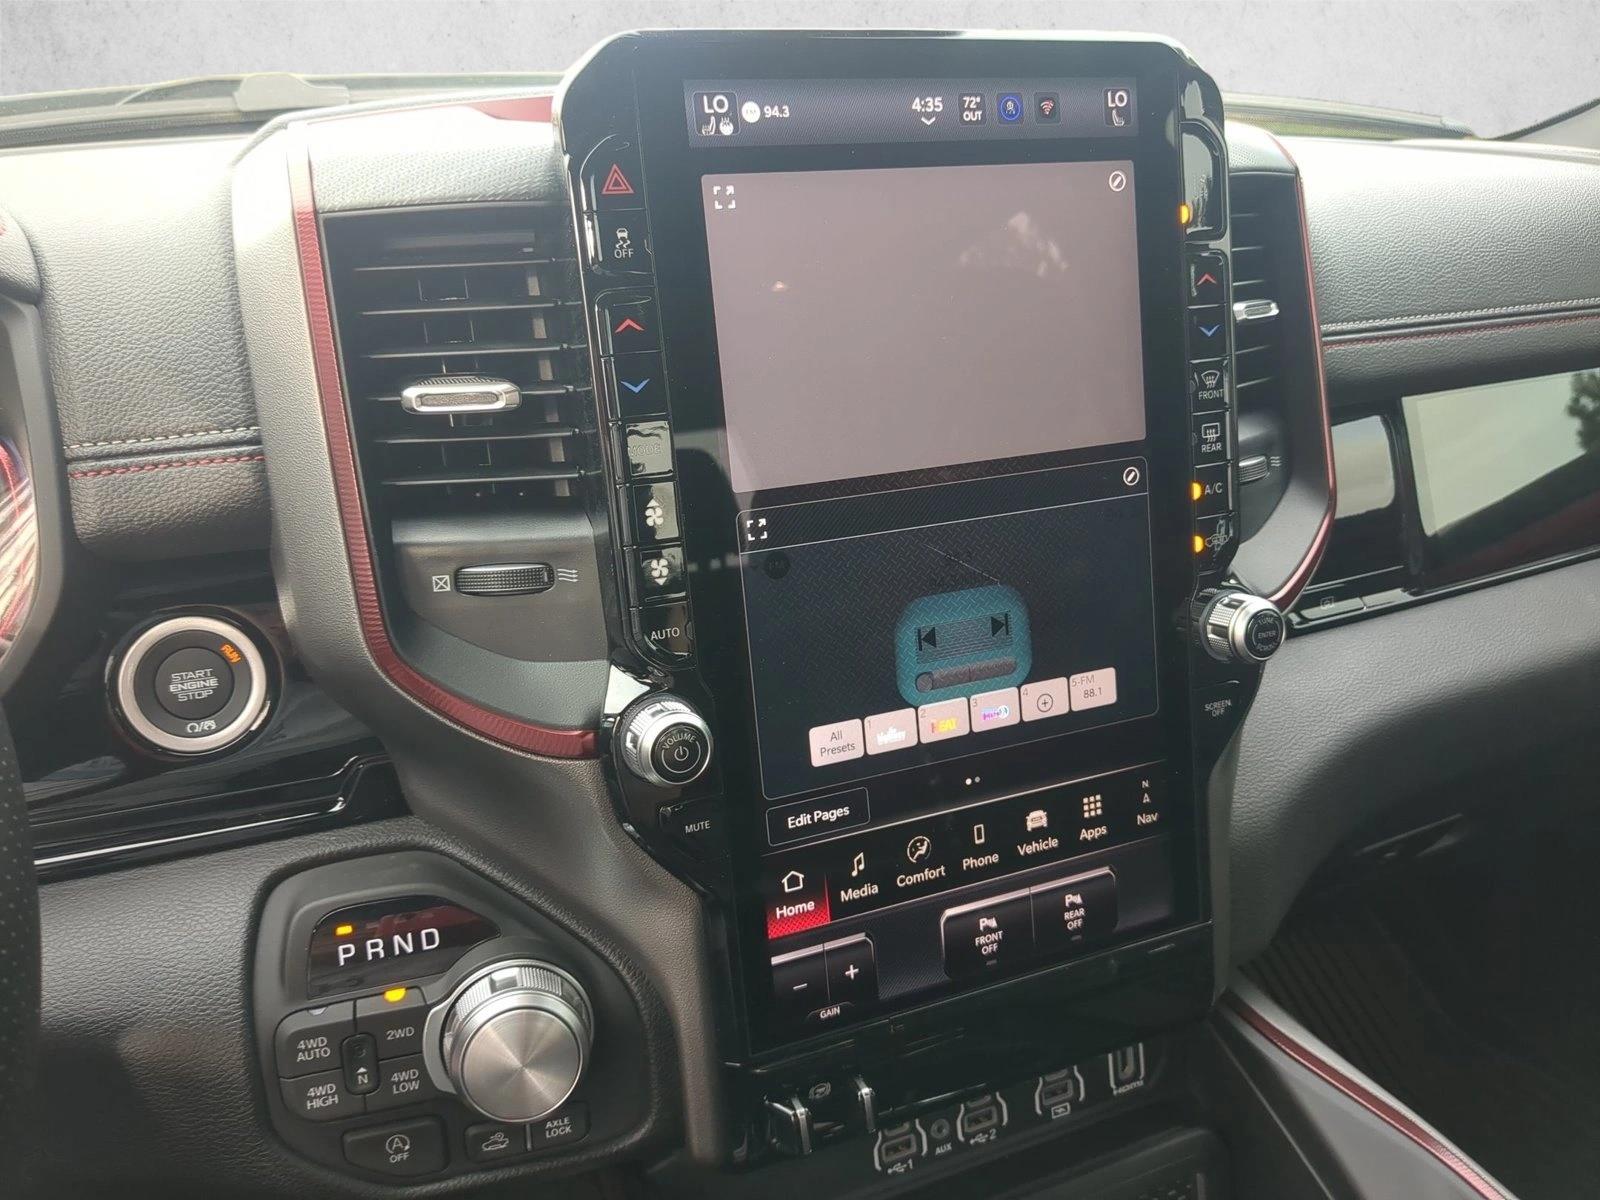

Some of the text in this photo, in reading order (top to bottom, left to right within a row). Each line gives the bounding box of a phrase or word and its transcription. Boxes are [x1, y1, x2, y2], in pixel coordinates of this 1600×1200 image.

[703, 95, 728, 113] LO
[911, 96, 943, 113] 4:35
[1107, 91, 1128, 108] LO
[763, 105, 790, 118] 94.3
[963, 110, 983, 122] OUT
[614, 249, 634, 259] OFF
[1198, 389, 1224, 400] FRONT
[1201, 443, 1222, 453] REAR
[1204, 482, 1223, 495] A/C
[650, 627, 680, 640] AUTO
[220, 644, 241, 663] RUN
[171, 668, 213, 681] START
[169, 678, 219, 692] ENGINE
[1071, 675, 1096, 688] 5-FM
[177, 689, 214, 702] STOP
[1083, 687, 1103, 699] 88.1
[972, 698, 978, 708] 3
[1204, 699, 1232, 711] SCREEN
[920, 708, 927, 718] 2
[1211, 707, 1225, 717] OFF
[662, 731, 697, 750] VOLUME
[830, 730, 843, 742] All
[820, 741, 856, 758] Presets
[787, 804, 850, 829] Edit Pages
[685, 820, 711, 833] MUTE
[775, 811, 1159, 919] Home Media Comfort Phone Vehicle Apps Nav
[1064, 908, 1085, 920] REAR
[1067, 919, 1083, 931] OFF
[975, 931, 1003, 947] FRONT
[338, 928, 440, 967] P R N D
[981, 943, 999, 955] OFF
[819, 1006, 841, 1019] GAIN
[386, 1026, 415, 1041] 2WD
[297, 1036, 328, 1051] 4WD
[297, 1046, 331, 1062] AUTO
[358, 1074, 368, 1084] N
[390, 1069, 419, 1083] 4WD
[306, 1083, 336, 1099] 4WD
[393, 1079, 420, 1095] LOW
[306, 1093, 339, 1110] HIGH
[545, 1116, 570, 1130] AXLE
[545, 1124, 572, 1138] LOCK
[989, 1128, 996, 1140] 2
[935, 1142, 952, 1155] AUX
[389, 1152, 409, 1163] OFF
